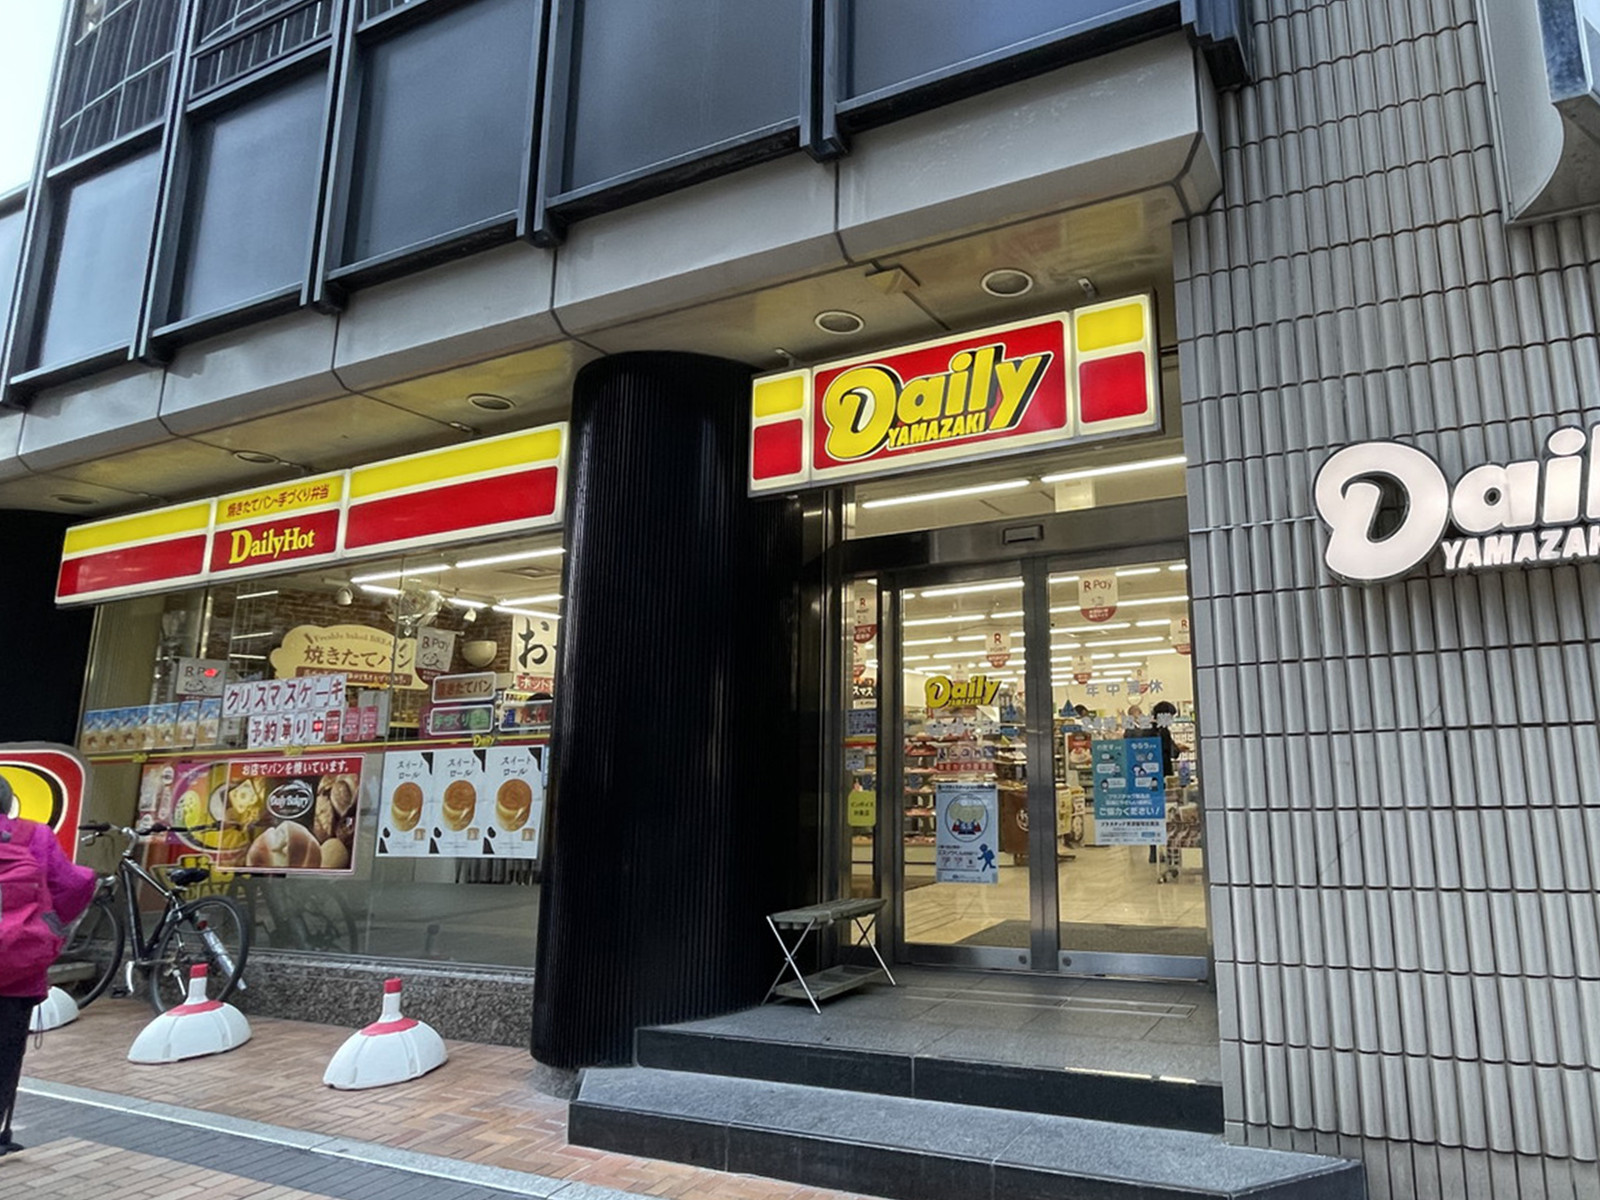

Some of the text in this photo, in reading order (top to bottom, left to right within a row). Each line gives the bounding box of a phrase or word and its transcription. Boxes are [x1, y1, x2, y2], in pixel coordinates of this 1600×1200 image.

[825, 343, 1053, 462] Daily
[887, 411, 987, 449] YAMAZAKI
[228, 527, 315, 564] DailyHot
[517, 616, 550, 669] お
[197, 666, 222, 679] Py
[227, 678, 343, 711] クリスマスケーキ
[925, 675, 1002, 709] Daily
